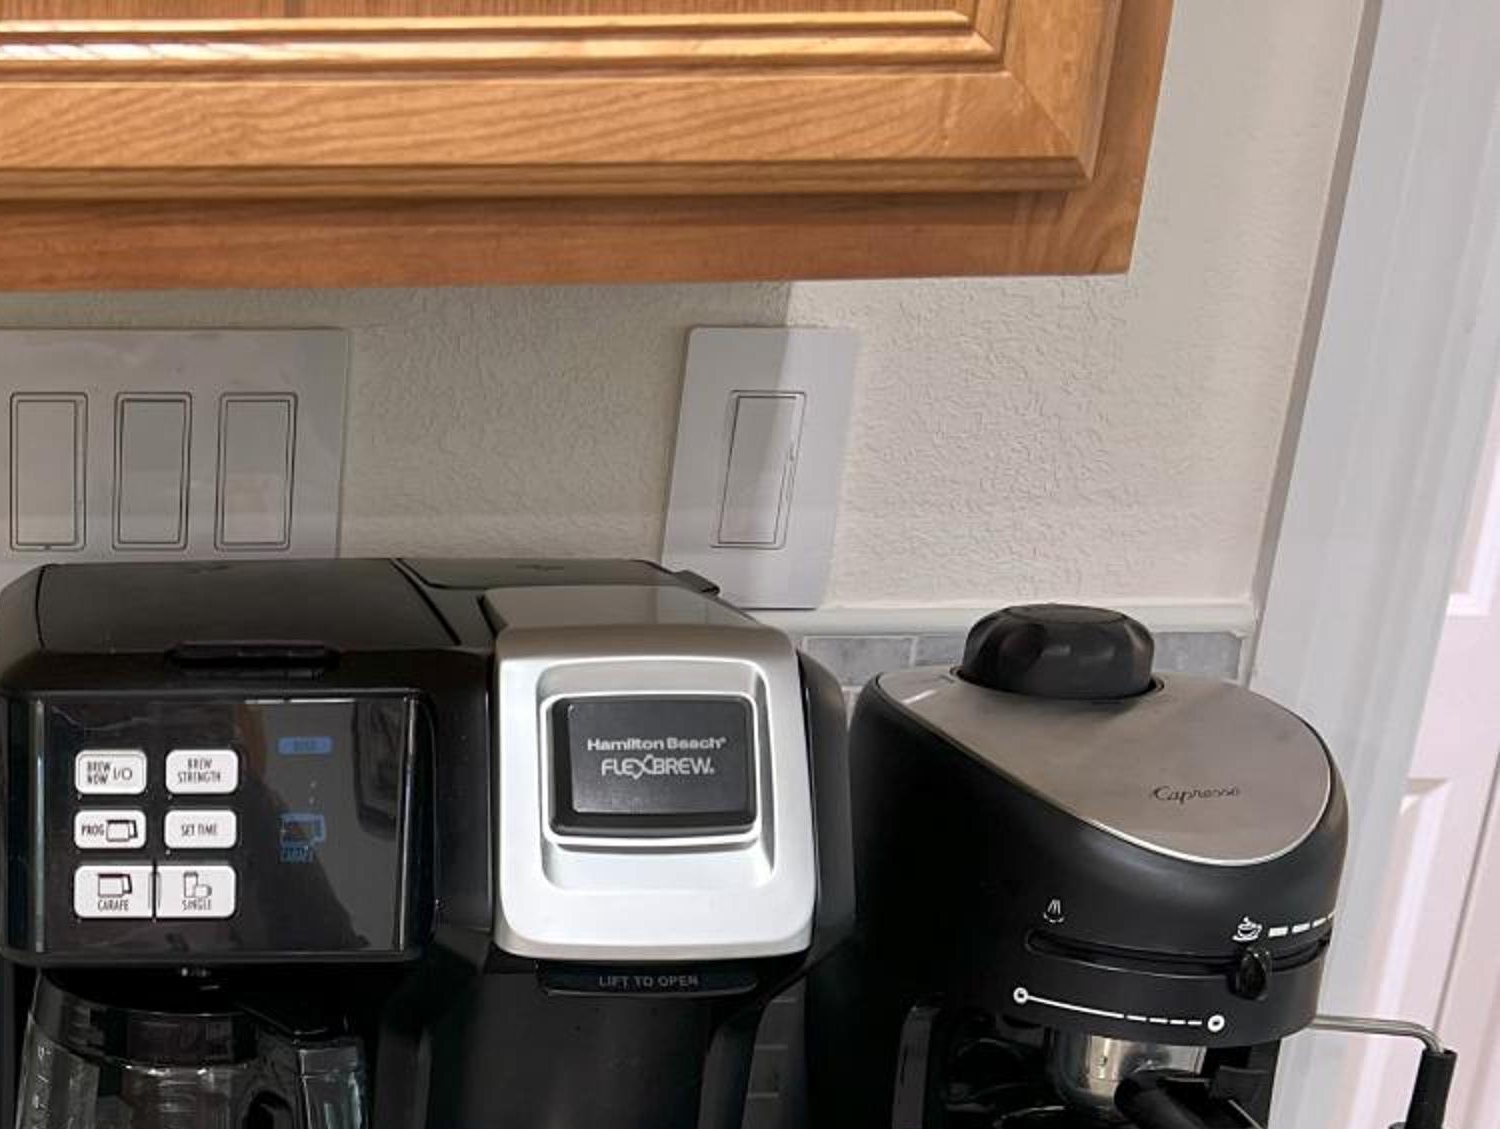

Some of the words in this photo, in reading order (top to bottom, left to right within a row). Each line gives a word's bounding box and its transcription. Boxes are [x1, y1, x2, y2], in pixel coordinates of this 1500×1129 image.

[587, 738, 664, 750] Hamilton
[87, 760, 111, 772] BREW
[187, 758, 212, 769] BREW
[87, 773, 108, 785] NOW
[177, 771, 221, 783] STRENGTH
[81, 824, 105, 836] PROG
[181, 825, 195, 836] SET
[198, 824, 218, 836] TIME
[97, 900, 129, 912] CARAFE
[182, 899, 212, 911] SINGLE
[600, 976, 629, 987] LIFT
[633, 976, 653, 987] TO
[657, 975, 699, 987] OPEN
